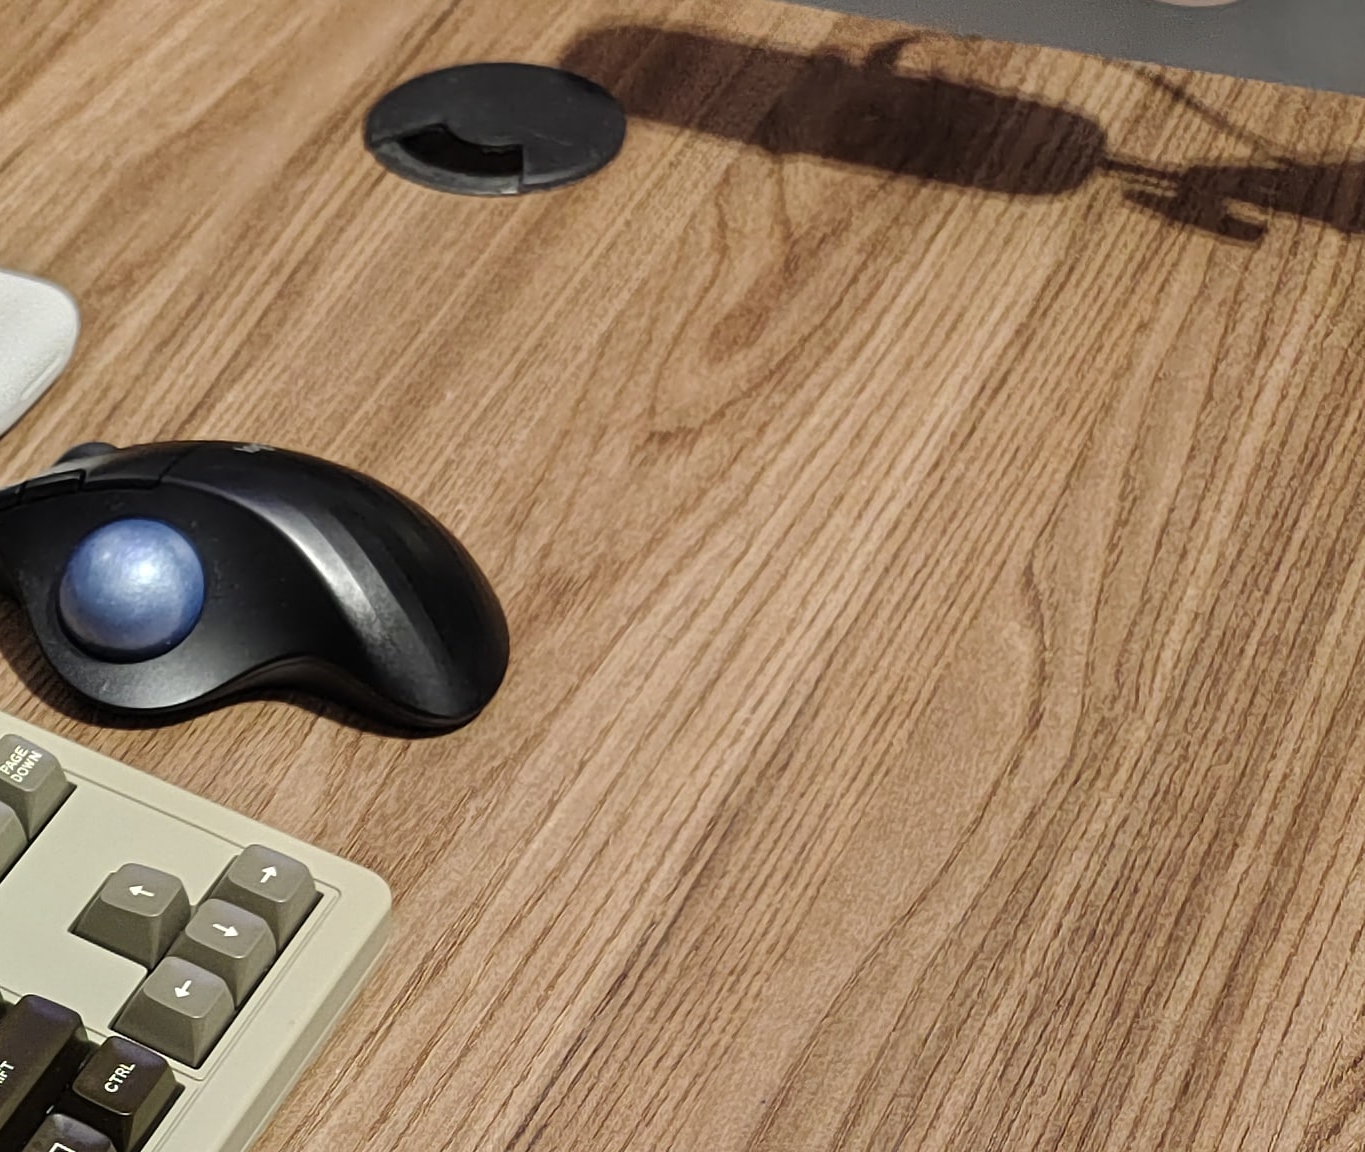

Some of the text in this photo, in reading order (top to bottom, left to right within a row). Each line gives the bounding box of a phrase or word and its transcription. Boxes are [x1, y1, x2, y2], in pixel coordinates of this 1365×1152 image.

[0, 745, 28, 776] PAGE
[10, 749, 42, 782] DOWN
[105, 1064, 135, 1092] CTRL
